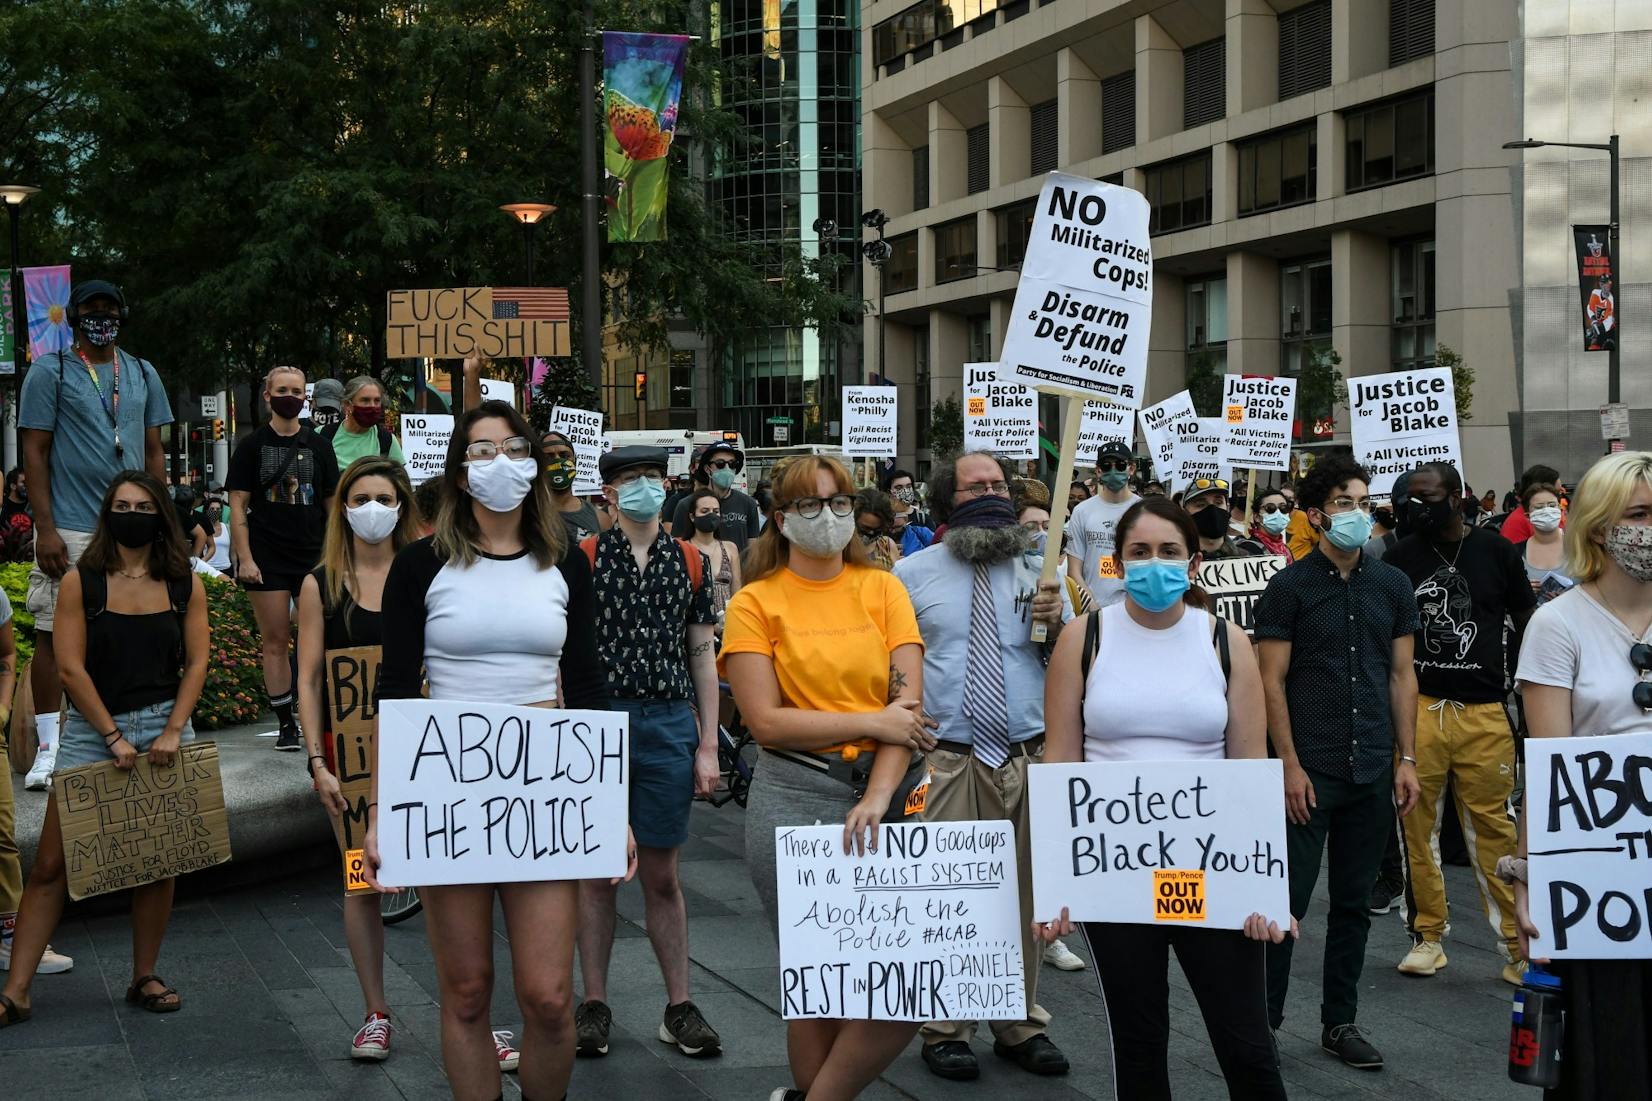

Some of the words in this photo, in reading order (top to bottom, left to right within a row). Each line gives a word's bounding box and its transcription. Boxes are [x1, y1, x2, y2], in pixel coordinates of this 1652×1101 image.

[1048, 186, 1107, 226] NO
[1051, 223, 1149, 265] Militarized
[1093, 257, 1149, 291] Cops!
[388, 288, 487, 321] FUCK
[1041, 290, 1130, 330] Disarm
[389, 323, 476, 355] THIS
[482, 320, 567, 357] SHIT
[1028, 309, 1039, 322] &
[1034, 317, 1128, 356] Defund
[1062, 353, 1078, 364] the
[1079, 355, 1126, 377] Police
[1017, 365, 1037, 378] Party
[1037, 371, 1049, 379] for
[1049, 373, 1081, 387] Socialism
[1087, 382, 1118, 395] Liberation
[1227, 380, 1291, 396] Justice
[986, 384, 1026, 398] Jacob
[1120, 387, 1135, 399] PSL
[1355, 376, 1445, 408] Justice
[848, 395, 895, 404] Kenosha
[992, 396, 1033, 407] Blake
[1244, 396, 1284, 409] Jacob
[858, 406, 888, 417] Philly
[1145, 407, 1165, 424] NO
[1249, 408, 1288, 421] Blake
[1359, 409, 1373, 417] for
[1382, 397, 1439, 421] Jacob
[314, 410, 340, 425] VOTE
[406, 419, 427, 429] NO
[554, 410, 600, 427] Justice
[994, 418, 1031, 426] Victims
[1090, 411, 1124, 424] Philly
[1391, 414, 1449, 433] Blake
[409, 430, 451, 438] Militarized
[567, 425, 596, 437] Jacob
[849, 426, 864, 434] Jail
[975, 429, 1003, 437] Racist
[1177, 423, 1199, 435] NO
[1234, 428, 1247, 436] All
[1249, 429, 1285, 439] Victims
[426, 438, 448, 448] Cops
[571, 435, 599, 447] Blake
[848, 436, 894, 444] Vigilantes!
[1097, 433, 1126, 443] Racist
[1230, 438, 1258, 447] Racist
[1260, 440, 1288, 449] Police
[413, 452, 446, 460] Disarm
[576, 453, 596, 461] ctims
[1197, 445, 1218, 455] Cop
[1249, 449, 1281, 457] Terror!
[1374, 449, 1391, 460] All
[1395, 445, 1449, 459] Victims
[578, 462, 598, 470] Police
[1182, 460, 1219, 469] Disarm
[1370, 462, 1411, 475] Racist
[1182, 470, 1220, 480] Defund
[1195, 563, 1230, 587] ACK
[1232, 559, 1280, 585] LIVES
[410, 713, 624, 785] ABOLISH
[64, 747, 212, 813] BLACK
[906, 793, 925, 806] NOW
[1068, 776, 1216, 828] Protect
[99, 786, 199, 836] LIVES
[391, 798, 470, 860] THE
[480, 796, 600, 860] POLICE
[71, 815, 212, 873] MATTER
[779, 828, 833, 859] There
[886, 825, 929, 860] NO
[935, 826, 978, 855] Good
[91, 862, 136, 885] JUSTICE
[142, 854, 162, 869] FOR
[166, 840, 210, 865] FLOYD
[1072, 831, 1176, 877] Black
[1196, 833, 1284, 878] Youth
[134, 871, 155, 883] FOR
[158, 861, 189, 877] JACOB
[797, 866, 816, 887] in
[826, 868, 841, 886] a
[853, 863, 922, 886] RACIST
[931, 861, 1005, 884] SYSTEM
[1154, 871, 1204, 879] Trump/Pence
[1159, 881, 1199, 898] OUT
[793, 894, 915, 929] Abolish
[925, 898, 969, 919] the
[1156, 898, 1204, 914] NOW
[833, 927, 911, 952] Police
[922, 923, 978, 944] #ACAB
[950, 952, 1020, 978] DANIEL
[783, 963, 850, 1016] REST
[853, 978, 867, 995] IN
[867, 960, 950, 1020] POWER
[957, 982, 1017, 1009] PRUDE
